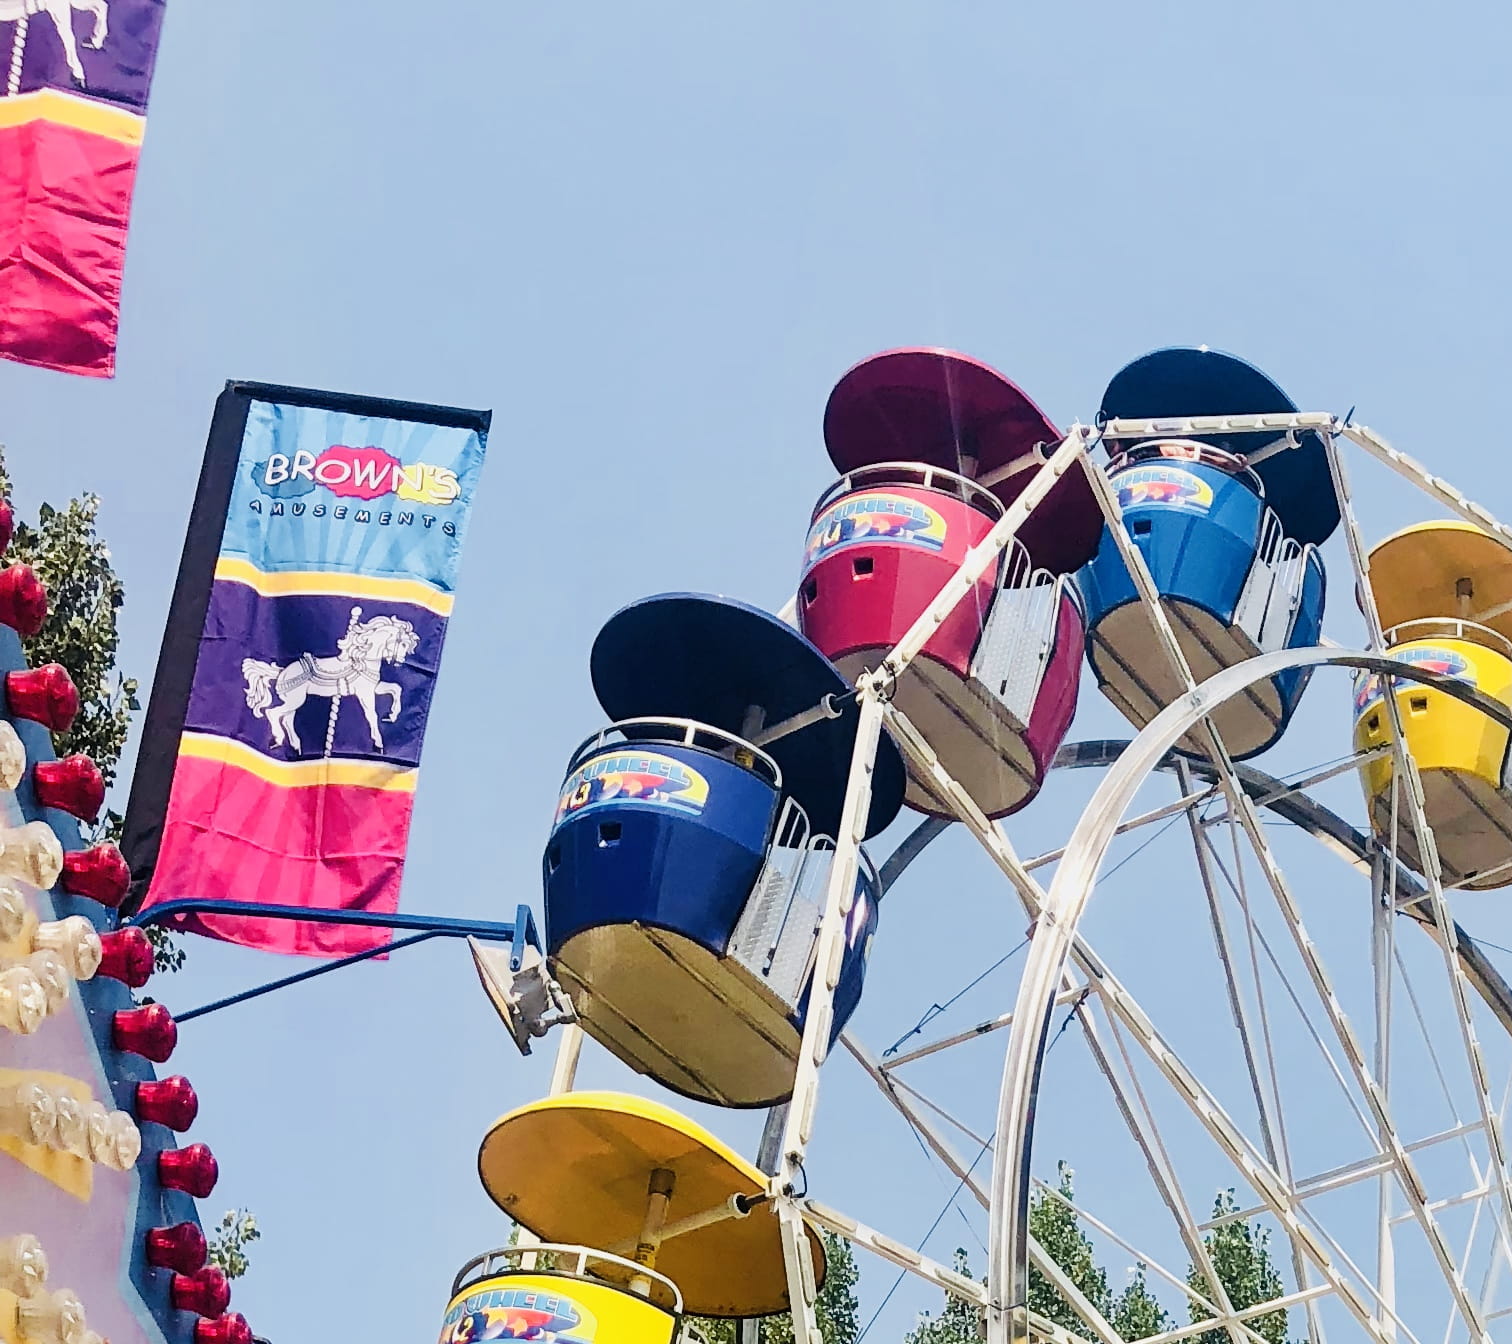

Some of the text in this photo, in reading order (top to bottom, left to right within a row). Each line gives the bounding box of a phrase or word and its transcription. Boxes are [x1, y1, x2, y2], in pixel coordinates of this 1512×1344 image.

[265, 449, 459, 500] BROWN'S
[250, 499, 456, 538] AMUSEMENTS
[465, 1290, 579, 1324] WHEEL
